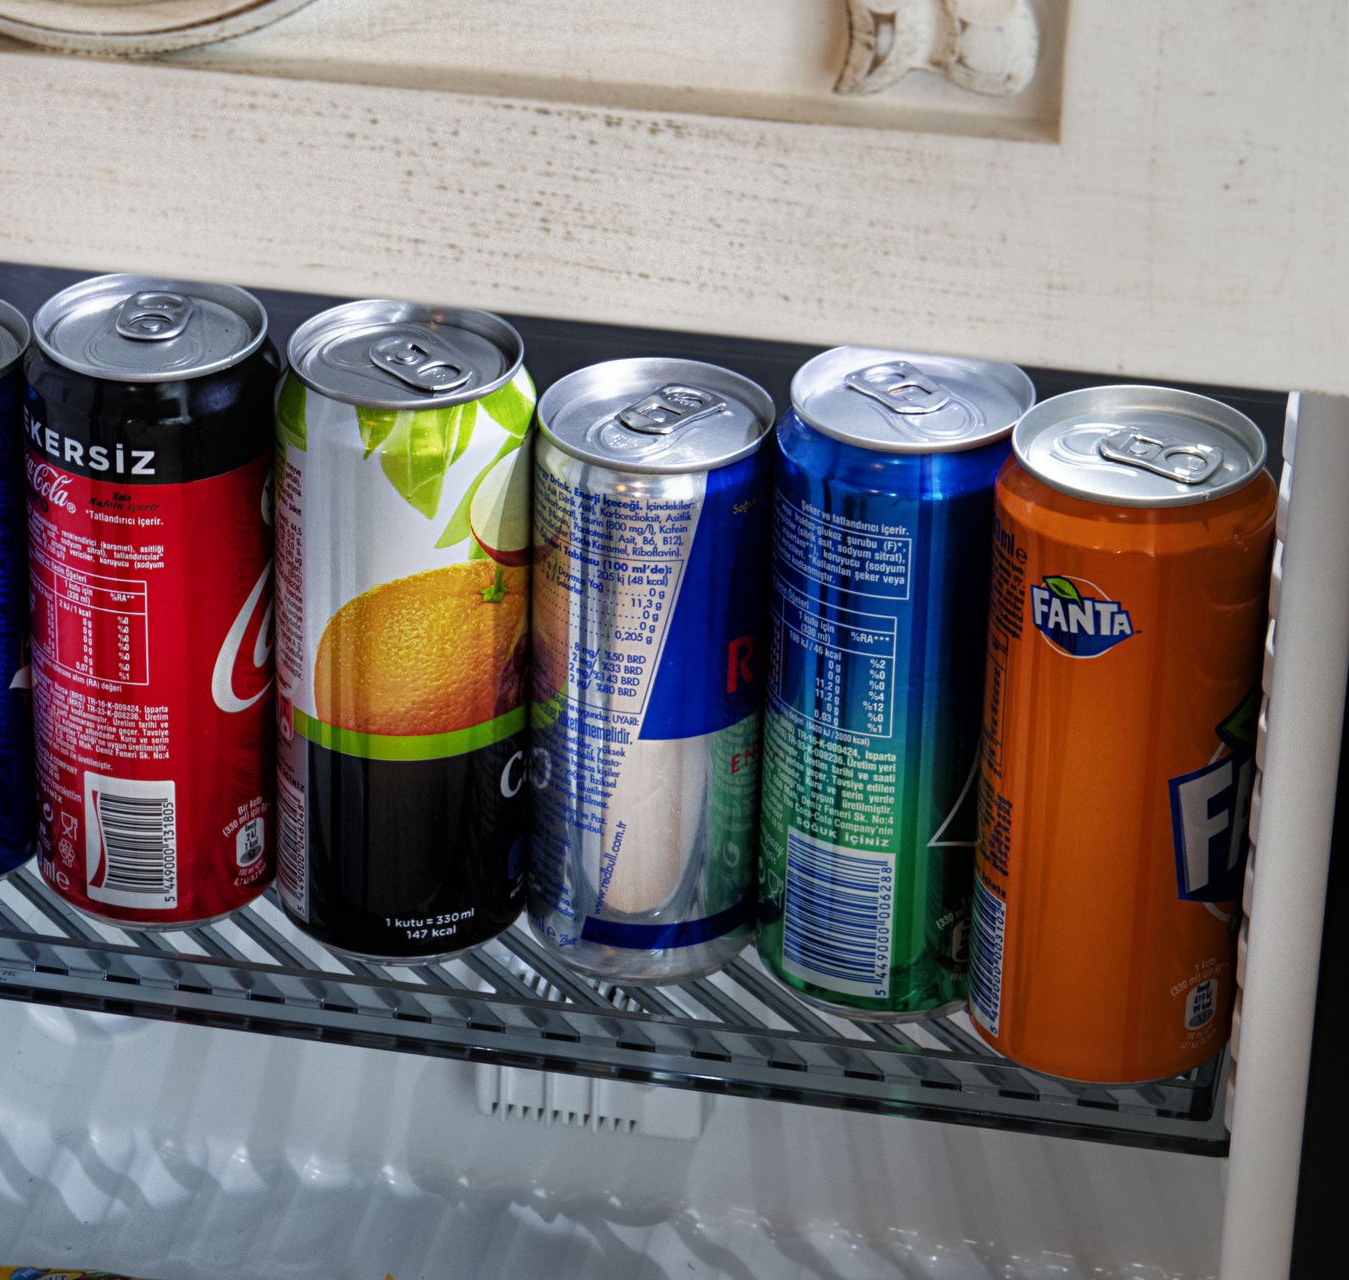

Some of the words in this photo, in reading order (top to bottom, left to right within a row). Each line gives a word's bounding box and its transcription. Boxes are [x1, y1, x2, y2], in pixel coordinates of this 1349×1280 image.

[574, 487, 601, 506] Enerji
[603, 493, 643, 512] İçeceği.
[645, 500, 695, 512] İçindekiler:
[138, 517, 163, 528] içerir.
[600, 506, 662, 524] Karbondioksit,
[666, 513, 693, 522] Asitlik
[605, 519, 627, 533] (800
[659, 523, 689, 534] Kafein
[821, 511, 831, 521] ve
[880, 524, 909, 536] içerir.
[618, 535, 638, 547] Asit,
[642, 535, 657, 547] B6,
[662, 536, 684, 548] B12),
[846, 535, 877, 549] şurubu
[591, 540, 630, 557] Karamel,
[632, 546, 682, 559] Riboflavin).
[837, 544, 872, 559] sodyum
[874, 552, 906, 564] sitrat),
[134, 561, 164, 570] (sodyum
[603, 560, 629, 573] (100
[823, 550, 861, 568] koruyucu
[865, 562, 906, 574] (sodyum
[596, 571, 615, 583] 205
[616, 573, 626, 586] kj
[627, 576, 644, 587] (48
[646, 574, 669, 588] kcal)
[854, 571, 880, 583] şeker
[883, 576, 906, 587] veya
[631, 598, 653, 609] 11,3
[1032, 586, 1133, 637] FANTA
[614, 631, 644, 643] 0,205
[604, 650, 625, 663] %50
[626, 654, 647, 664] BRD
[825, 647, 842, 661] kcal
[623, 665, 644, 676] BRD
[620, 677, 641, 687] BRD
[617, 687, 637, 697] BRD
[160, 721, 169, 729] ve
[120, 735, 137, 744] Kuru
[150, 737, 169, 745] serin
[143, 729, 169, 738] Tavsiye
[834, 730, 853, 744] 2000
[852, 735, 871, 748] kcal)
[139, 751, 151, 760] Sk.
[153, 751, 170, 760] No:4
[597, 744, 626, 757] yüksek
[864, 750, 897, 763] Isparta
[846, 756, 877, 770] Üretim
[878, 763, 897, 774] yeri
[831, 764, 854, 778] tarihi
[857, 771, 869, 781] ve
[872, 773, 896, 784] saati
[804, 776, 823, 790] Kuru
[826, 785, 837, 795] ve
[841, 789, 864, 801] serin
[868, 793, 895, 806] yerde
[832, 775, 864, 791] Tavsiye
[866, 783, 896, 794] edilen
[841, 799, 895, 815] üretilmiştir.
[794, 801, 833, 826] Coca-Cola
[833, 818, 894, 836] Company'nin
[823, 804, 852, 820] Feneri
[853, 811, 869, 823] Sk.
[872, 815, 895, 826] No:4
[796, 815, 838, 839] SOĞUK
[844, 831, 891, 848] İÇİNİZ
[593, 820, 627, 915] www.redbull.com.tr
[165, 895, 177, 904] 5
[877, 865, 893, 920] 006288
[395, 917, 424, 928] kutu
[406, 930, 427, 940] 147
[432, 924, 457, 938] kcal
[874, 926, 891, 980] 449000
[874, 988, 887, 997] 5
